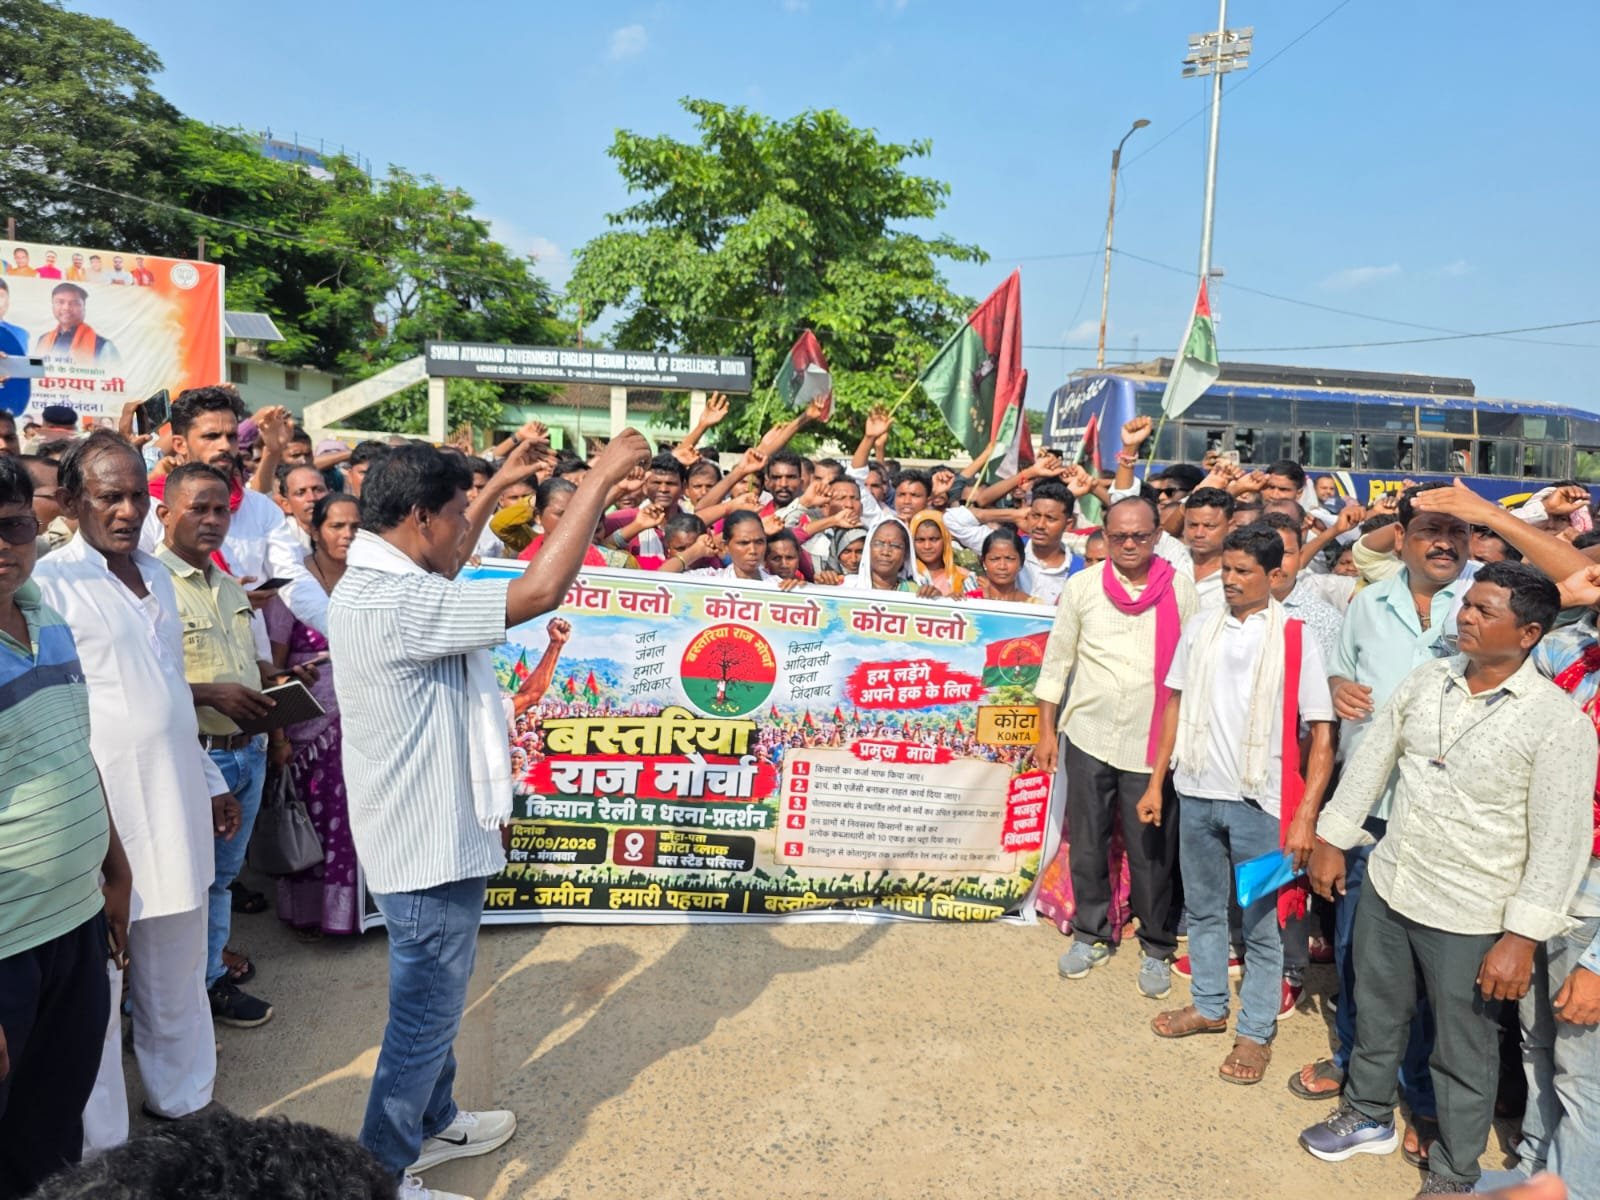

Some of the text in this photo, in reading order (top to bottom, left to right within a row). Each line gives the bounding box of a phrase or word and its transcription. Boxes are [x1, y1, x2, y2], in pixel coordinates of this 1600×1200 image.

[507, 349, 558, 366] GOVERNMENT
[560, 352, 592, 368] ENGLISH
[594, 353, 625, 369] MEDIUM
[627, 355, 656, 371] SCHOOL
[658, 356, 668, 372] OF
[670, 358, 719, 376] EXCELLENCE,
[721, 360, 746, 376] KONTA
[38, 377, 125, 392] कश्यप जी
[619, 586, 672, 614] चलो
[705, 593, 762, 621] कोंटा
[770, 600, 820, 626] चलो
[852, 606, 908, 635] कोंटा
[916, 614, 967, 640] चलो
[635, 630, 658, 644] जल
[686, 627, 729, 662] बस्तरिया
[733, 628, 755, 643] राज
[636, 645, 667, 660] जंगल
[788, 641, 824, 655] किसान
[784, 651, 832, 670] आदिवासी
[633, 662, 665, 680] हमारा
[789, 671, 819, 686] एकता
[867, 663, 931, 685] हम लड़ेंगे
[628, 677, 672, 696] अधिकार
[791, 684, 833, 701] जिंदाबाद
[860, 680, 972, 703] अपने हक के लिए
[994, 709, 1038, 728] कोंटा
[542, 707, 756, 755] बस्तरिया
[997, 732, 1031, 741] KONTA
[860, 743, 899, 761] प्रमुख
[551, 752, 759, 798] राज मोर्चा
[797, 764, 806, 774] 1.
[843, 767, 852, 775] का
[888, 770, 904, 779] किया
[795, 780, 805, 791] 2.
[832, 782, 842, 791] को
[927, 790, 942, 799] दिया
[526, 795, 768, 828] किसान रैली व धरना-प्रदर्शन
[793, 798, 803, 809] 3.
[512, 825, 547, 836] दिनांक
[791, 817, 802, 827] 4.
[511, 837, 596, 850] 07/09/2026
[790, 844, 800, 855] 5.
[510, 850, 528, 861] दिन
[538, 850, 578, 862] मंगलवार
[658, 855, 678, 866] बस
[706, 856, 746, 869] परिसर
[485, 888, 516, 907] गल
[535, 881, 592, 907] जमीन
[609, 884, 662, 909] हमारी
[666, 890, 729, 910] पहचान
